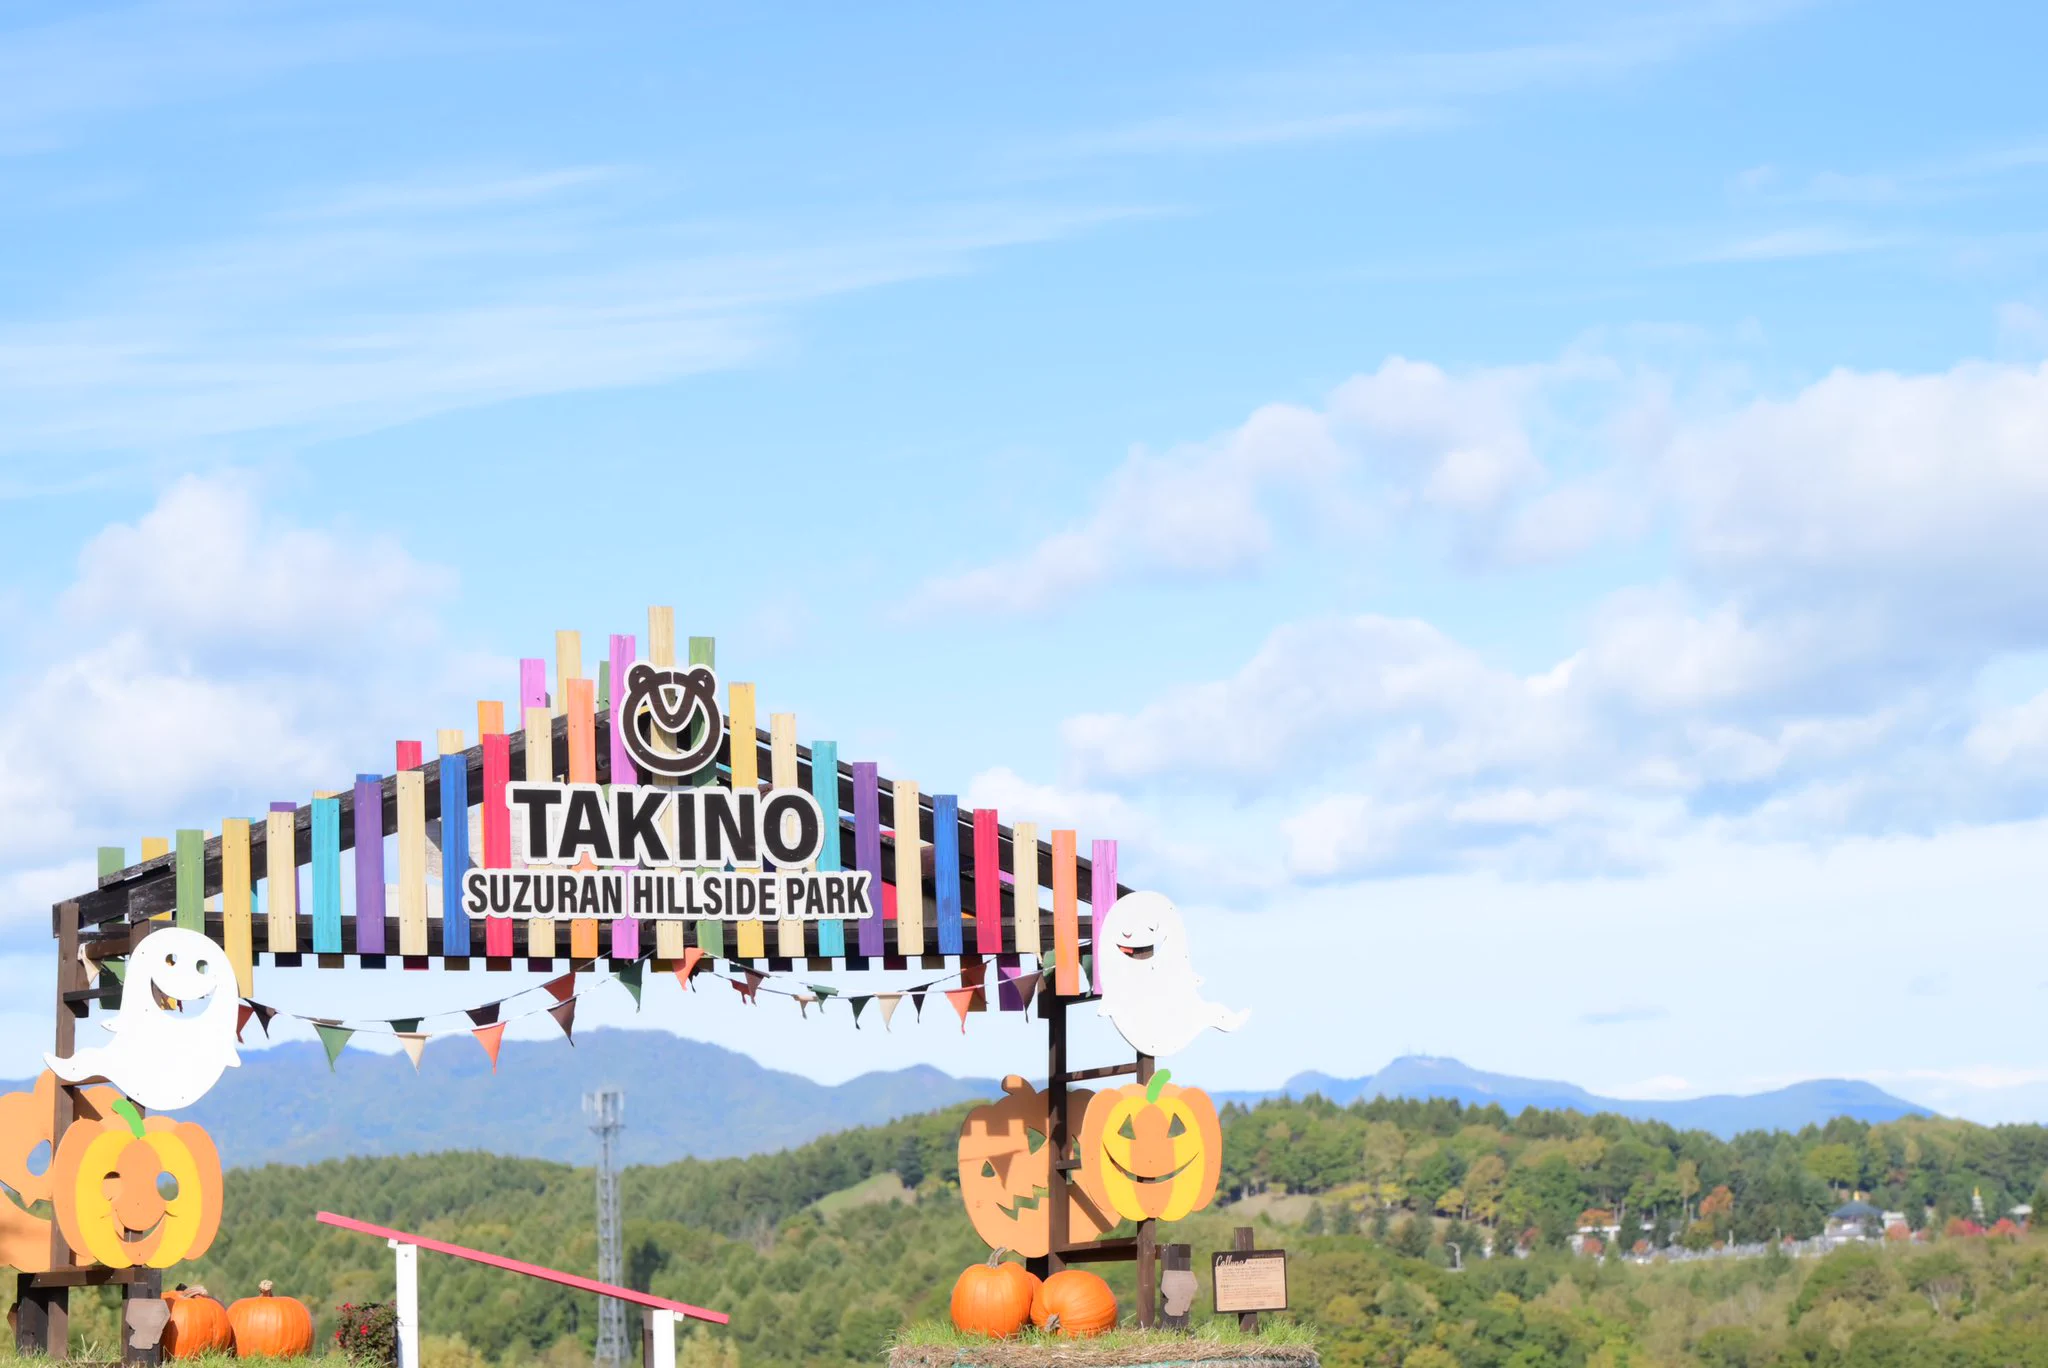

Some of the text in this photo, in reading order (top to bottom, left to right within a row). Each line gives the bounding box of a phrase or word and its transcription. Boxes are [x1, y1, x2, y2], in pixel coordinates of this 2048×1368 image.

[512, 788, 820, 863] TAKINO
[467, 873, 869, 916] SUZURAN HILLSIDE PARK
